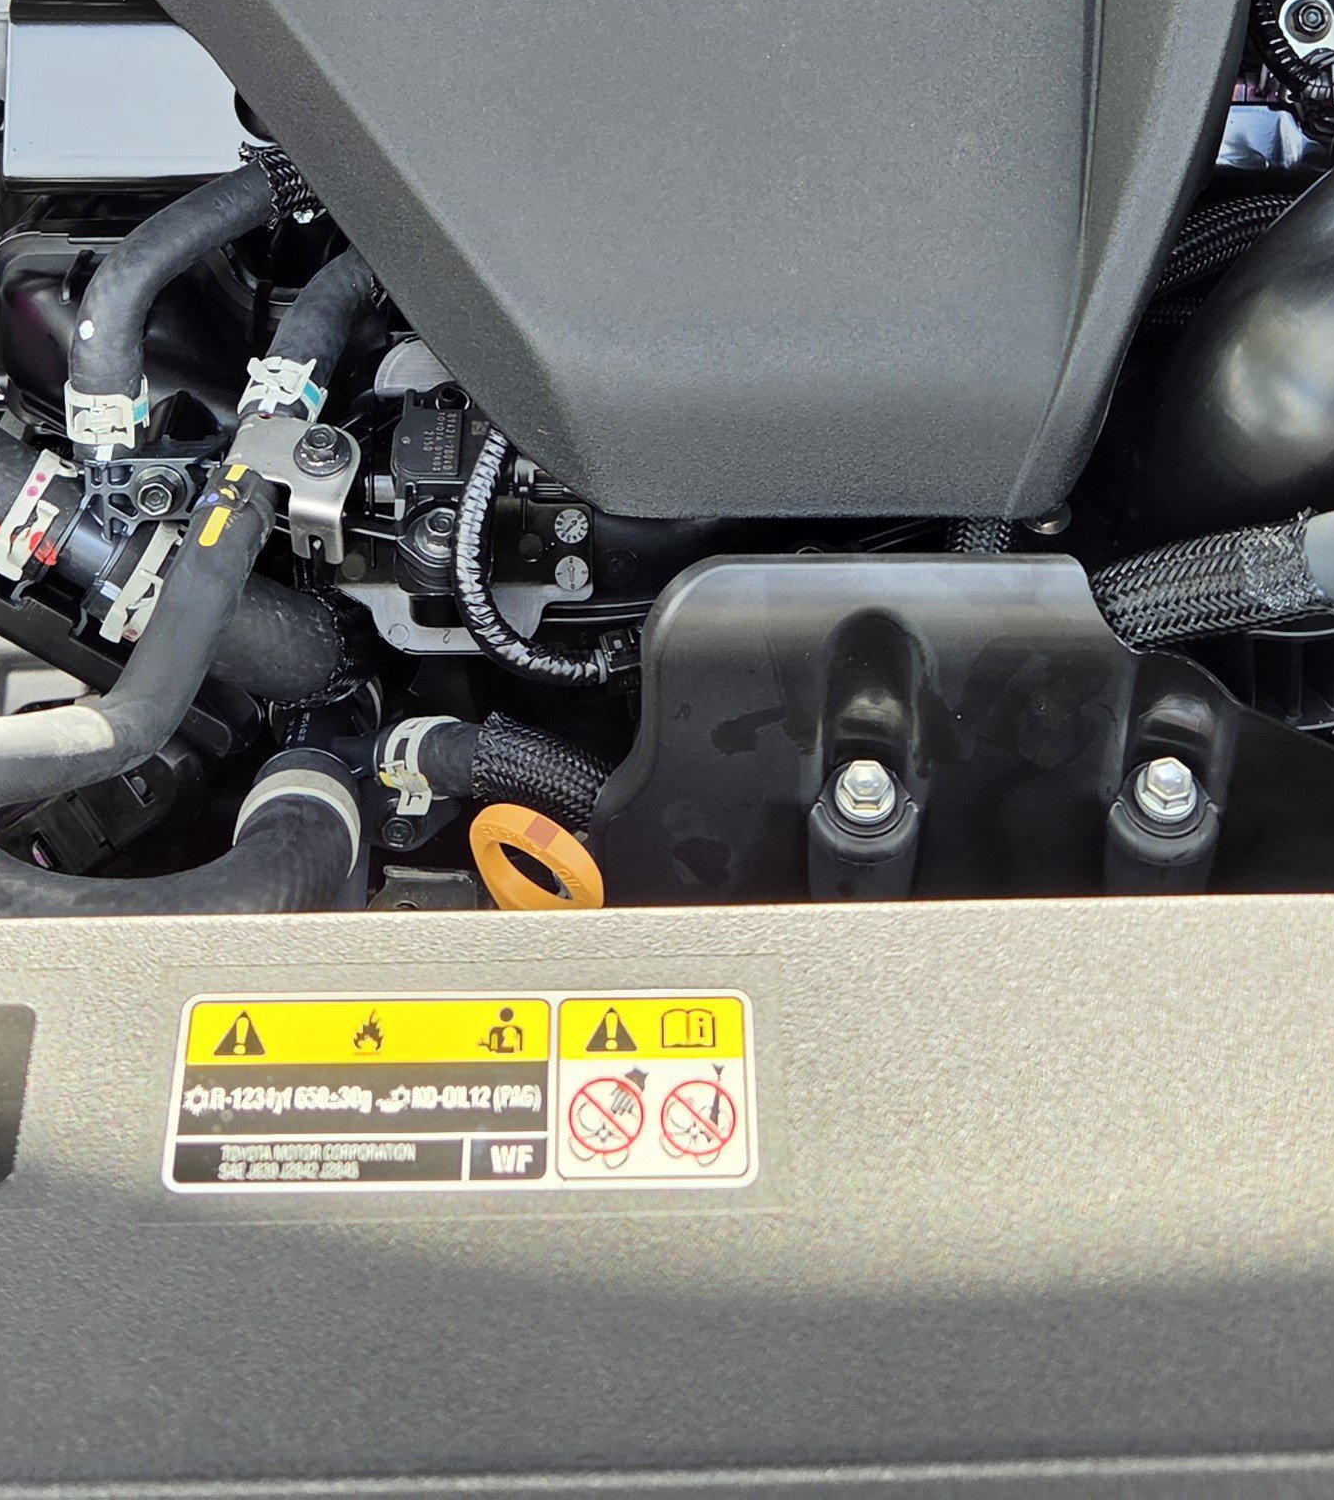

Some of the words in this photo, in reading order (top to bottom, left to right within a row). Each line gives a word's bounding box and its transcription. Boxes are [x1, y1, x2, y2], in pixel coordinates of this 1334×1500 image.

[220, 1145, 273, 1162] TOYOTA
[273, 1144, 323, 1162] MOTOR
[323, 1143, 417, 1162] CORPORATION
[490, 1145, 534, 1174] WF
